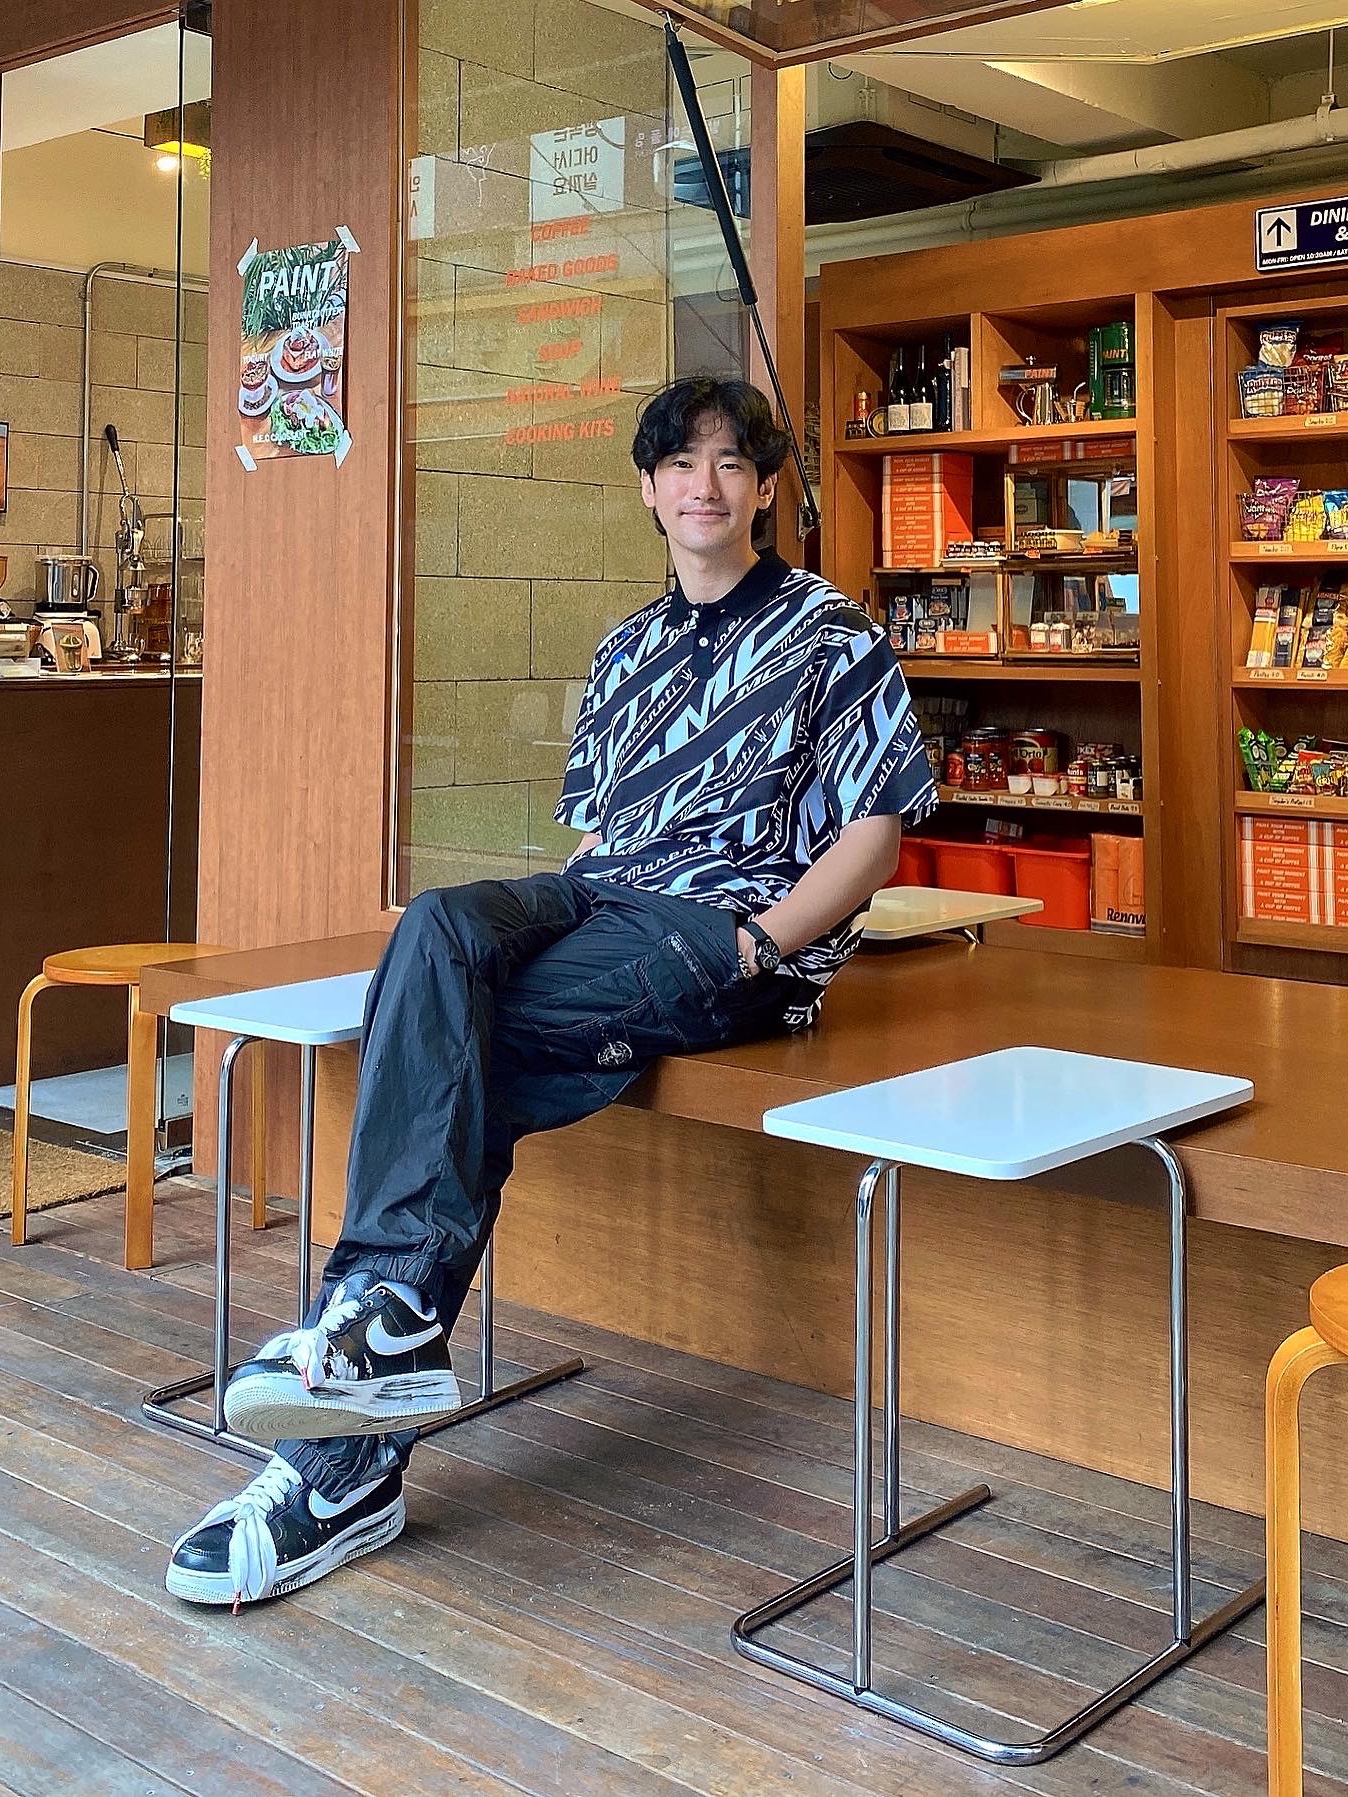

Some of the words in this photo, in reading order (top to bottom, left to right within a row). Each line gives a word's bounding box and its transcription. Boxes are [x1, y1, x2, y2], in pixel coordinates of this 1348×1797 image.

[531, 215, 592, 242] COFFEE
[1310, 206, 1348, 227] DINI
[562, 252, 620, 278] GOODS
[259, 260, 337, 301] PAINT
[505, 422, 575, 446] COOKING
[579, 416, 616, 438] KITS
[857, 756, 900, 819] serati
[621, 844, 708, 882] Masera
